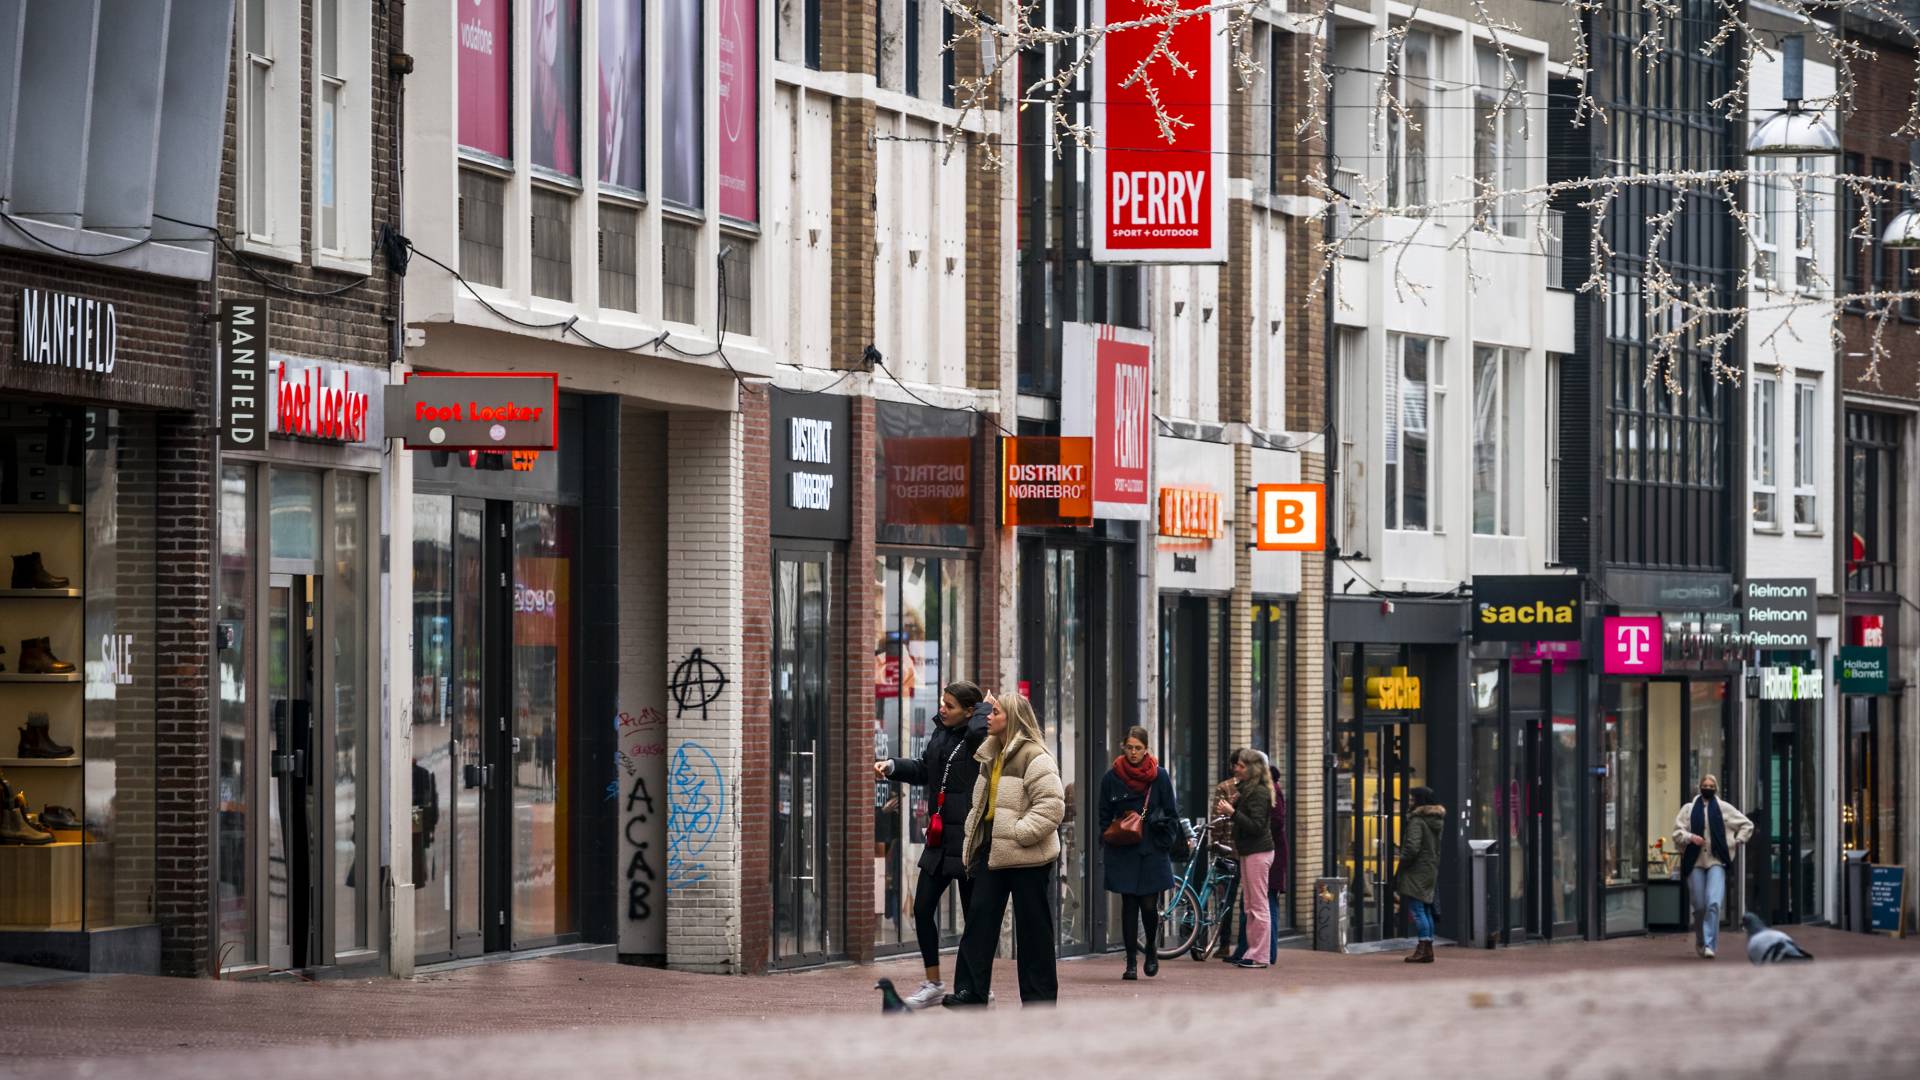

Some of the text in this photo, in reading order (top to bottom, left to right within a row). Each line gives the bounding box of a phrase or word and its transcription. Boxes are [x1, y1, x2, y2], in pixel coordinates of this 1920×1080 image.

[461, 17, 493, 55] vodafone
[1112, 170, 1205, 225] PERRY
[1113, 229, 1199, 237] SPORT + OUTDOOR
[23, 288, 116, 373] MANFIELD
[231, 305, 255, 443] MANFIELD
[277, 361, 368, 443] Foot Locker
[415, 401, 543, 422] Foot Locker
[1115, 362, 1147, 469] PERRY
[792, 417, 832, 464] DISTRIKT
[1009, 464, 1083, 481] DISTRIKT
[1277, 499, 1304, 535] B
[102, 634, 133, 684] SALE
[1617, 625, 1650, 665] T
[1843, 660, 1879, 669] Holland
[1851, 669, 1884, 679] Barrett
[626, 778, 654, 921] ACAB
